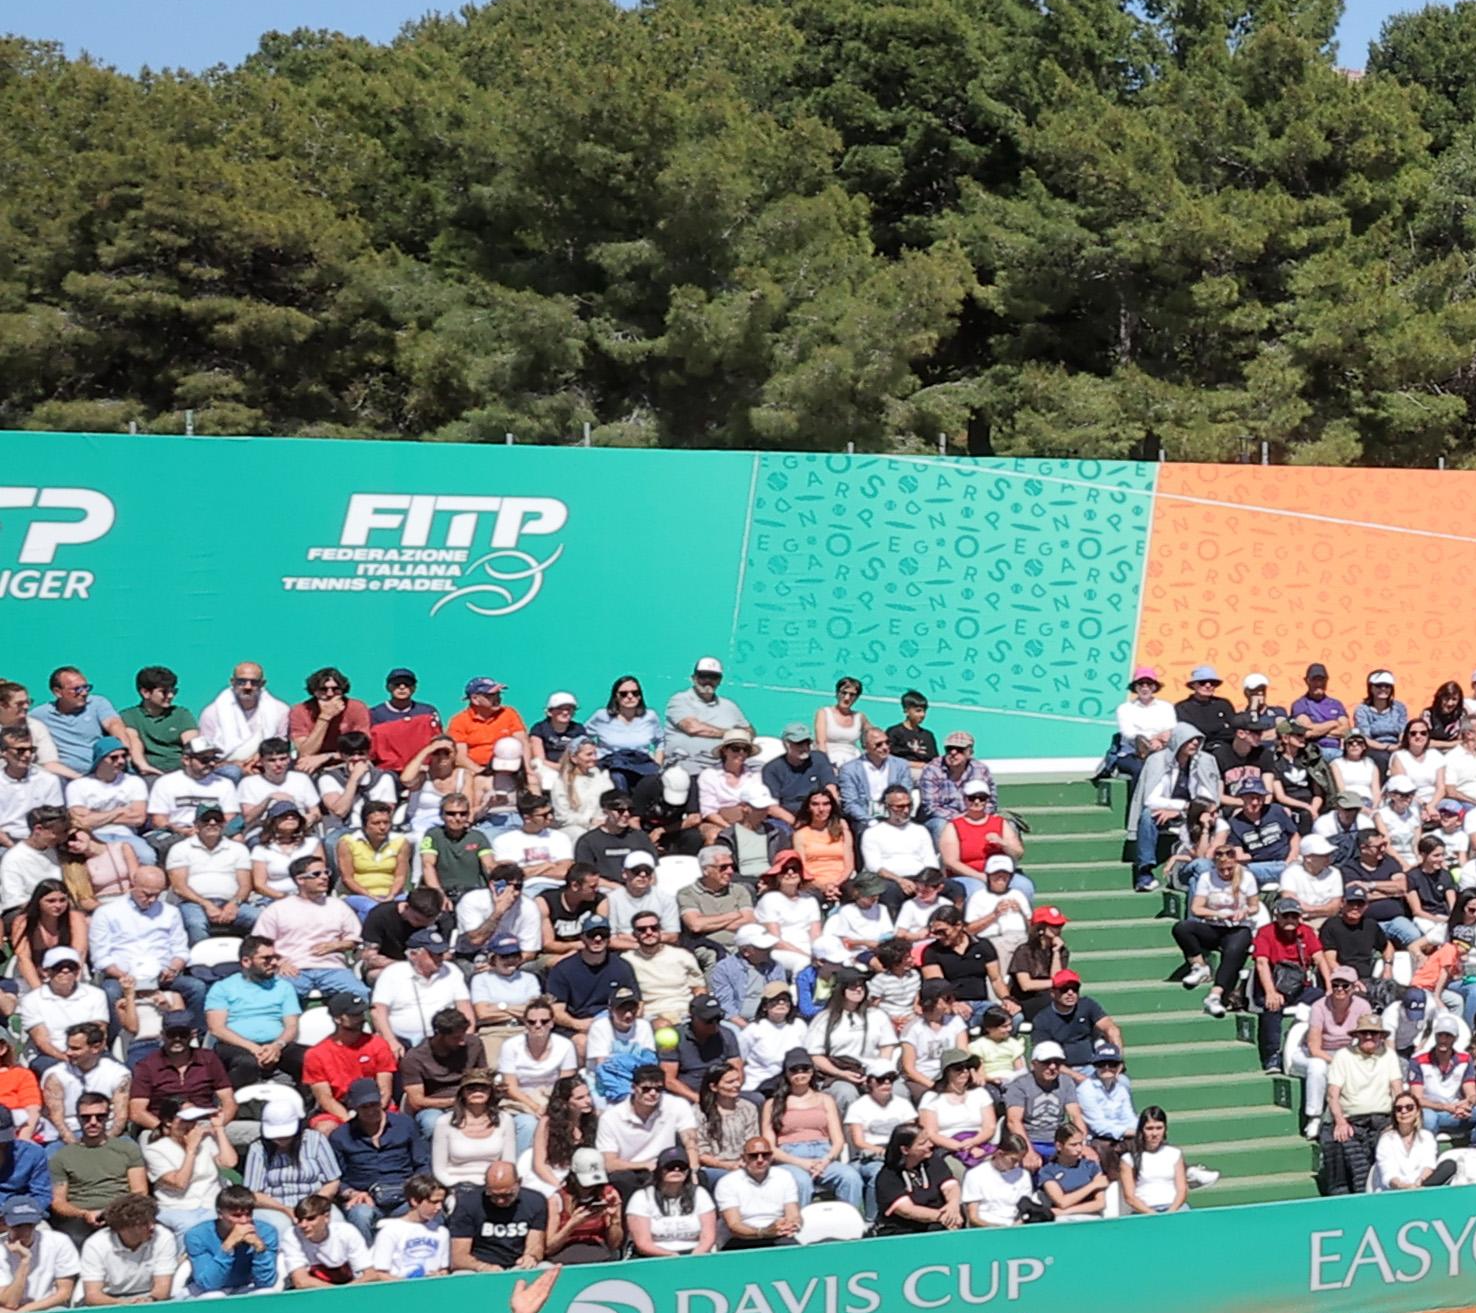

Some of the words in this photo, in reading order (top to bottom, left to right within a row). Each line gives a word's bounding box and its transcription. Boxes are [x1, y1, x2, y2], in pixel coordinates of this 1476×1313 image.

[340, 493, 568, 548] FITP
[306, 545, 470, 563] FEDERAZIONE
[355, 561, 463, 577] ITALIANA
[281, 576, 367, 592] TENNIS
[368, 578, 382, 591] e
[382, 576, 458, 593] PADEL
[481, 1222, 529, 1238] BOSS
[902, 1257, 1047, 1309] CUP
